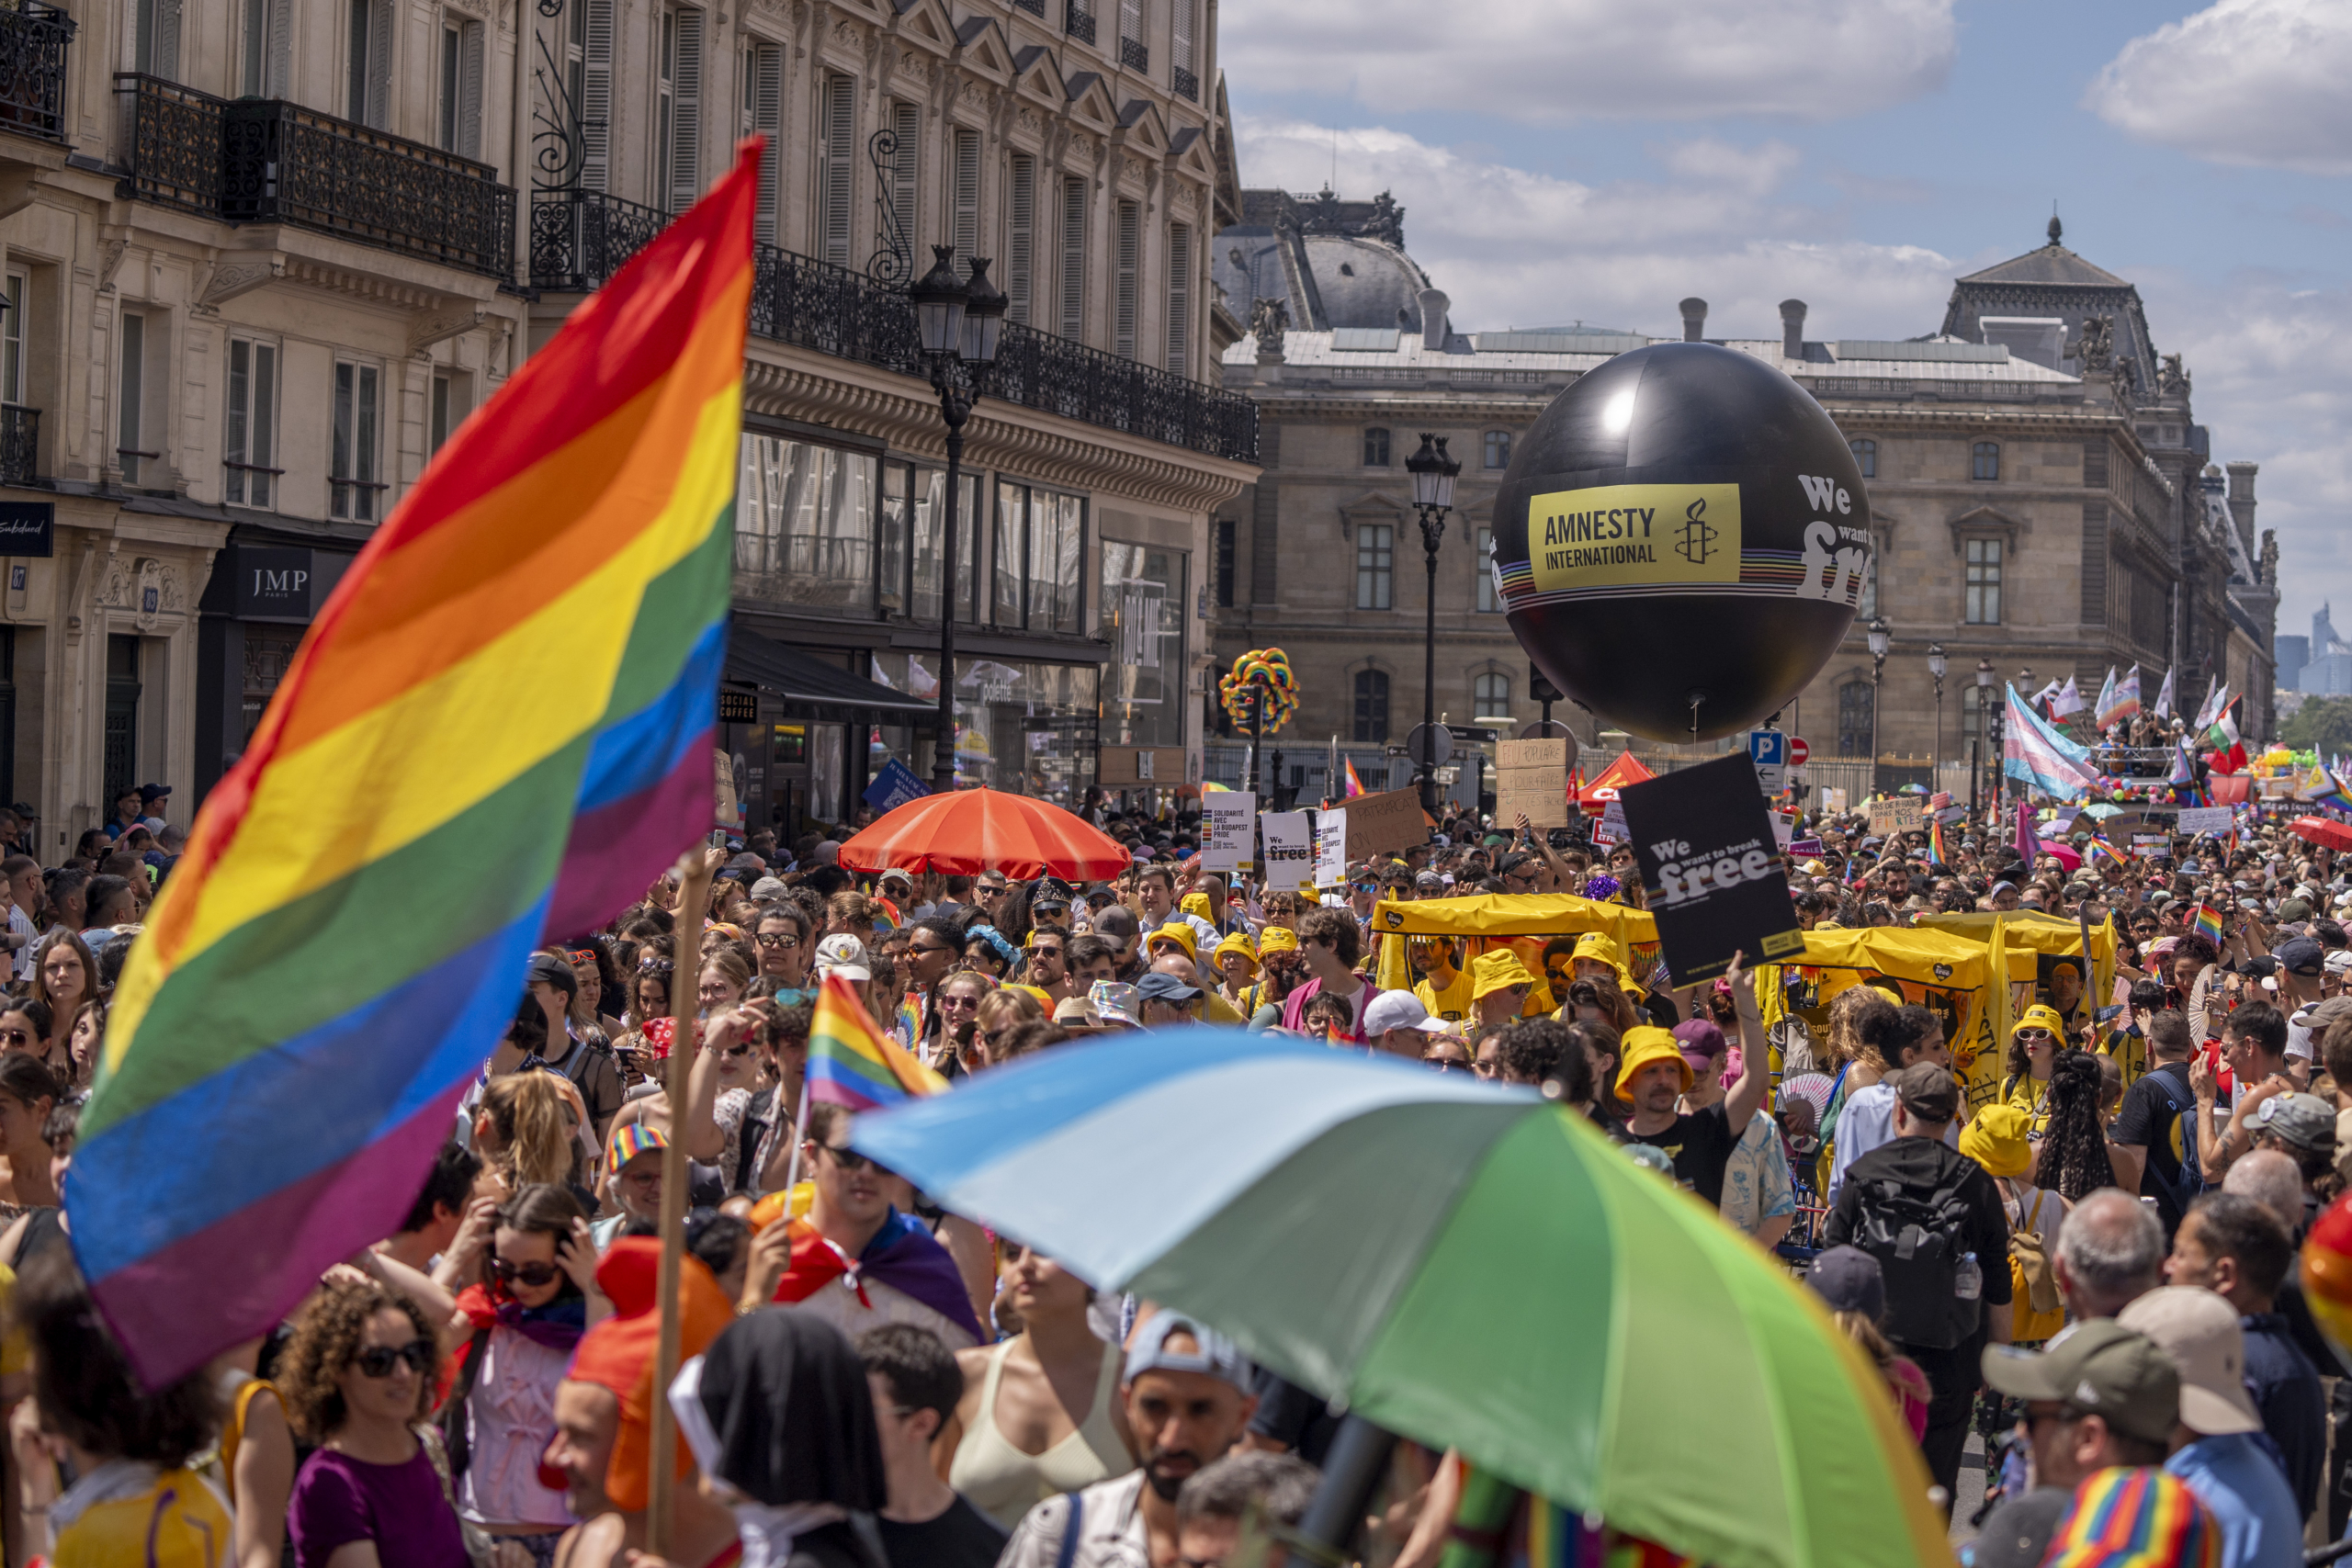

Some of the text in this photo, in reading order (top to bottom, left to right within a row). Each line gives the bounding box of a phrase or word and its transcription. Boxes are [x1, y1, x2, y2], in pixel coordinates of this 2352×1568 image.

[1797, 474, 1851, 515] We
[1544, 507, 1656, 546] AMNESTY
[1838, 525, 1868, 544] want
[1545, 544, 1657, 570] INTERNATIONAL
[13, 569, 25, 588] 87
[254, 569, 308, 597] JMP
[145, 591, 156, 610] 89
[720, 694, 754, 706] SOCIAL
[983, 678, 1012, 707] polette
[719, 707, 754, 718] COFFEE
[1502, 744, 1561, 765] FEU POPULAIRE
[1758, 737, 1774, 759] P
[1355, 796, 1416, 821] PATRIARCAT
[1525, 795, 1565, 807] LES FACHOS
[1870, 803, 1883, 811] PAS
[1884, 801, 1894, 810] DE
[1875, 808, 1912, 818] DANS NOS
[1321, 825, 1339, 835] SOLIDARITÉ
[1270, 845, 1307, 861] free
[1326, 840, 1341, 848] BUDAPEST
[1650, 839, 1690, 863] We
[1680, 852, 1713, 868] want
[1713, 848, 1725, 858] to
[1726, 838, 1762, 855] break
[1657, 849, 1770, 905] free
